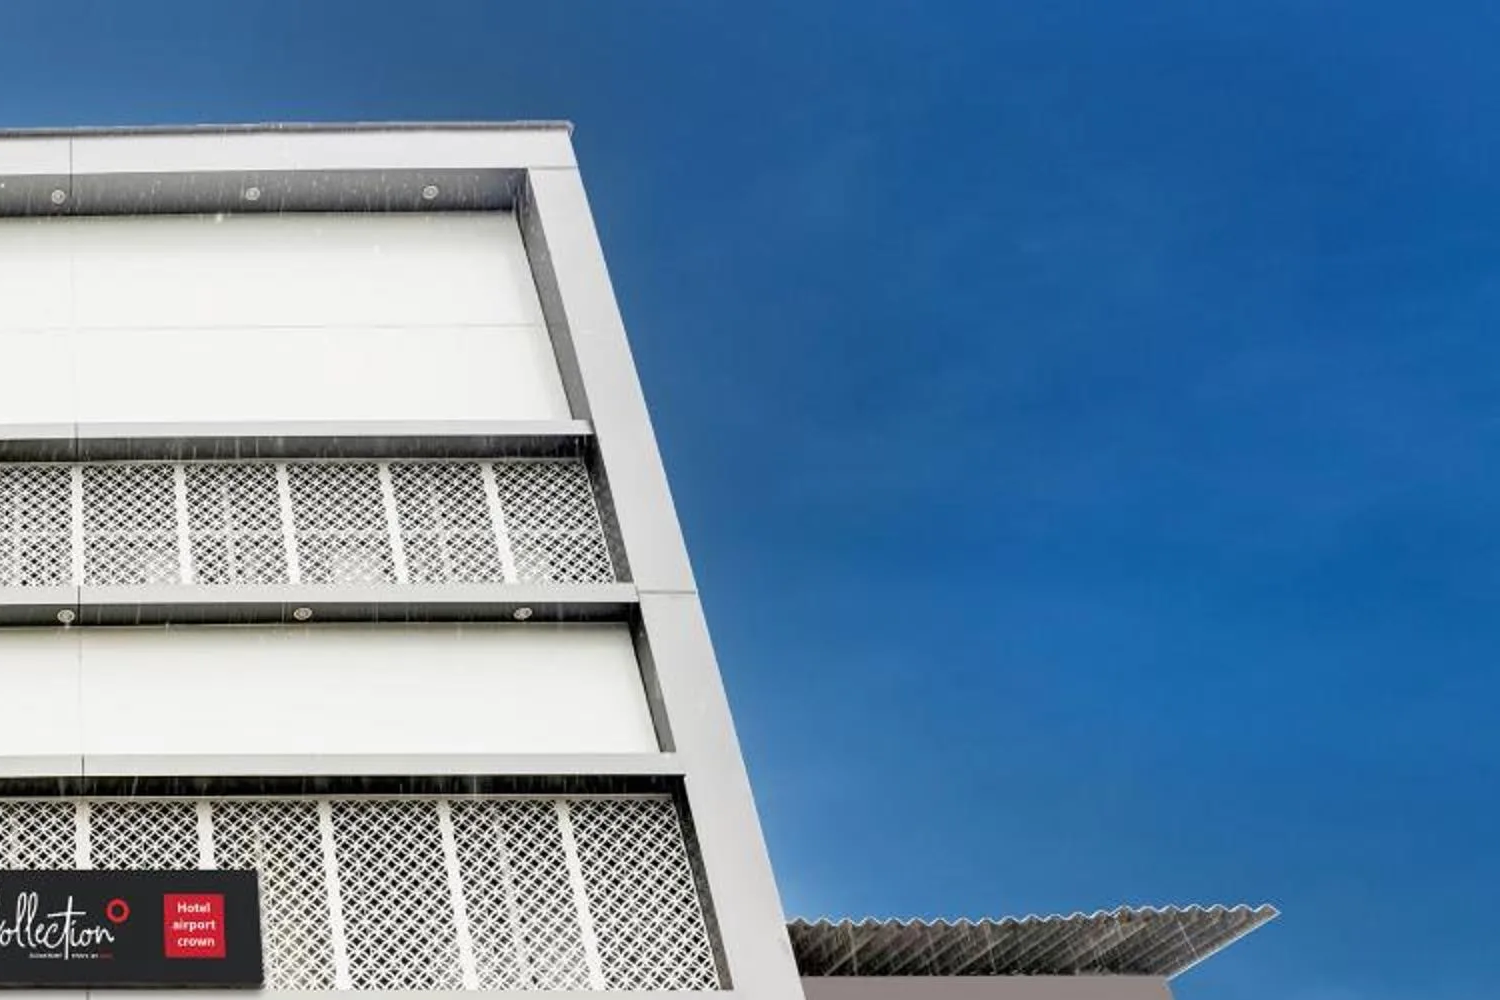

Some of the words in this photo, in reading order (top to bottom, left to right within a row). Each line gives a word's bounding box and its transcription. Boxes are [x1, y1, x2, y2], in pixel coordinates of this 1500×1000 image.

[177, 901, 212, 913] Hotel
[172, 918, 217, 932] airport
[177, 936, 216, 947] crown
